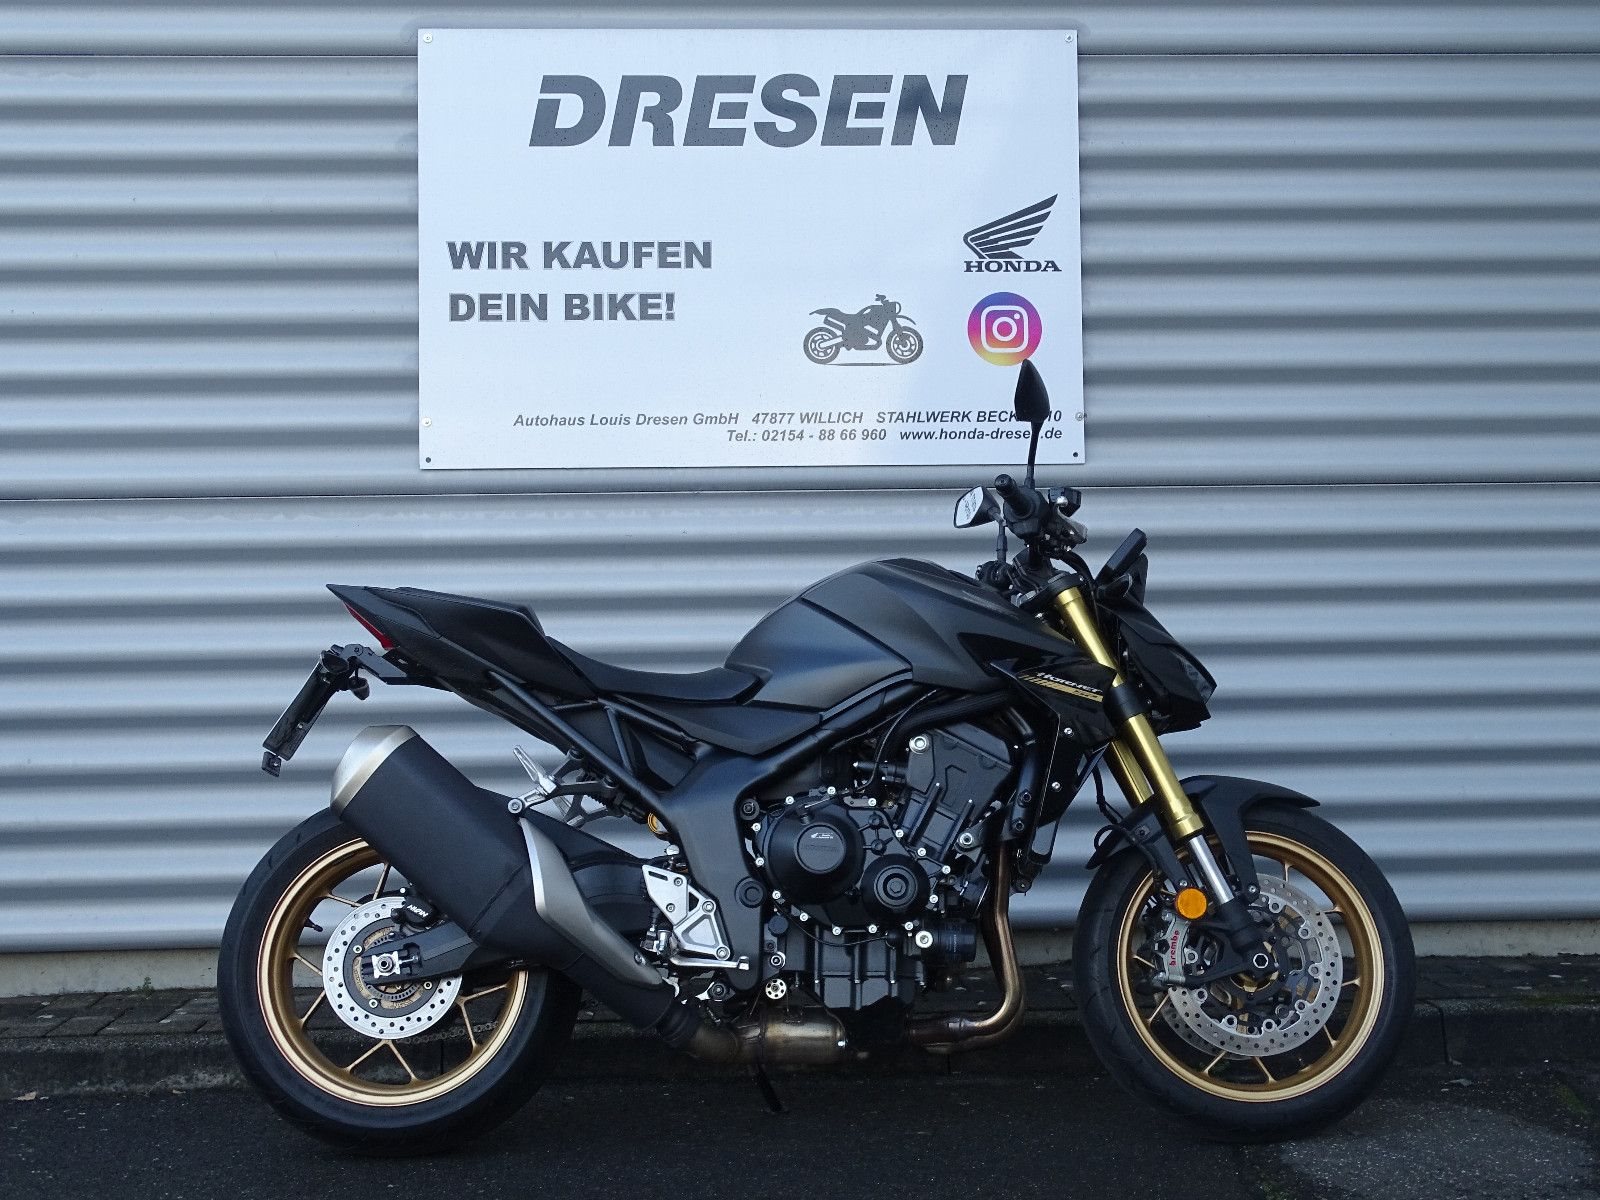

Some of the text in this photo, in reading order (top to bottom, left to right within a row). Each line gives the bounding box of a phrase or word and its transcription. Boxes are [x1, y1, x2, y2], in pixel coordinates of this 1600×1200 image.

[528, 73, 969, 148] DRESEN
[446, 239, 713, 271] WIR KAUFEN
[963, 260, 1063, 273] HONDA
[448, 291, 676, 323] DEIN BIKE!
[512, 413, 586, 426] Autohaus
[589, 413, 632, 425] Louis
[635, 413, 689, 425] Dresen
[692, 412, 740, 425] GmbH
[751, 412, 796, 424] 47877
[799, 411, 864, 424] WILLICH
[875, 410, 973, 423] STAHLWERK
[976, 410, 1032, 422] BECK
[726, 429, 758, 442] Tel.:
[761, 429, 805, 442] 02154
[818, 429, 836, 441] 88
[839, 429, 857, 441] 66
[861, 428, 887, 441] 960
[899, 427, 1063, 441] www.honda-drese.de
